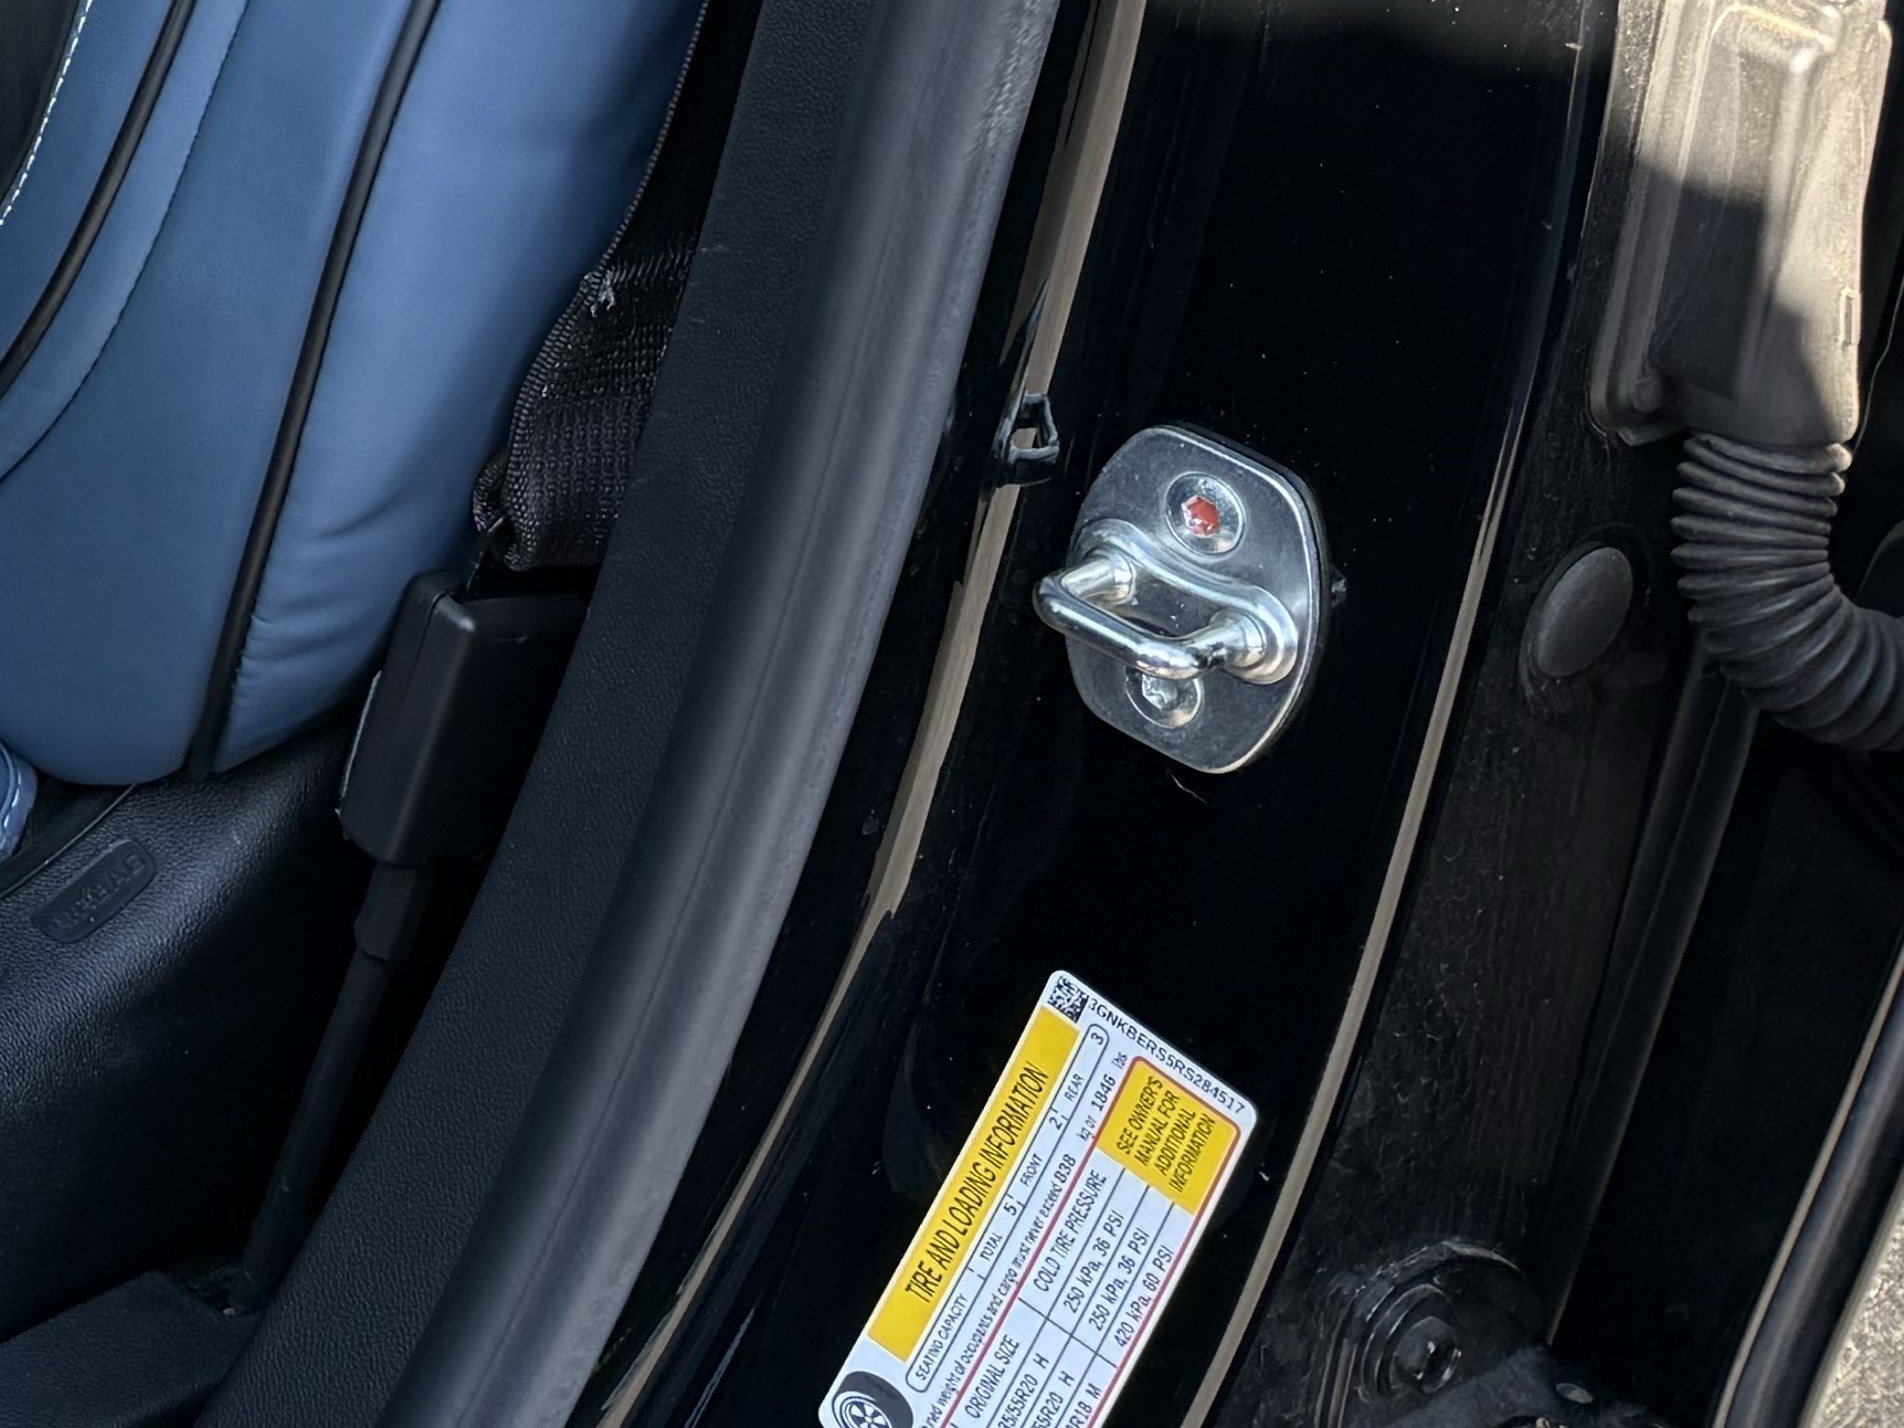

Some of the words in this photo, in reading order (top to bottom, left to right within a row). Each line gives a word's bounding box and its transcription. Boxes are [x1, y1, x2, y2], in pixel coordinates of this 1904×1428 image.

[978, 1061, 1049, 1170] INFORMATION
[1116, 1127, 1139, 1155] SEE
[1127, 1076, 1163, 1131] OWNER'S
[1134, 1117, 1169, 1166] MANUAL
[1157, 1090, 1180, 1119] FOR
[1154, 1108, 1197, 1176] ADDITIONAL
[1166, 1113, 1216, 1193] INFORMATION
[915, 1340, 944, 1381] SEATING
[938, 1293, 968, 1340] CAPACITY
[979, 1232, 1003, 1261] TOTAL
[1003, 1202, 1017, 1216] 5
[1020, 1153, 1043, 1187] FRONT
[1049, 1117, 1063, 1131] 2
[1064, 1073, 1084, 1101] REAR
[1091, 1032, 1104, 1045] 3
[936, 1372, 961, 1407] weight
[954, 1360, 966, 1375] of
[960, 1314, 993, 1364] occupants
[986, 1293, 1003, 1316] and
[997, 1268, 1018, 1297] cargo
[1012, 1242, 1031, 1268] must
[1024, 1216, 1044, 1245] never
[1039, 1181, 1063, 1218] exceed
[1053, 1154, 1076, 1184] 838
[1085, 1115, 1097, 1129] or
[1091, 1073, 1116, 1112] 1846
[1111, 1052, 1128, 1070] lbs
[941, 1161, 996, 1236] LOADING
[1033, 1256, 1061, 1292] COLD
[1050, 1229, 1076, 1258] TIRE
[1064, 1169, 1107, 1235] PRESSURE
[904, 1260, 943, 1303] TIRE
[925, 1229, 960, 1271] AND
[1063, 1286, 1085, 1314] 250
[1092, 1237, 1110, 1257] 36
[1103, 1210, 1124, 1237] PSI
[1088, 1304, 1110, 1332] 250
[1117, 1255, 1136, 1275] 36
[1127, 1227, 1150, 1255] PSI
[1114, 1321, 1135, 1347] 420
[1142, 1272, 1160, 1292] 60
[1152, 1244, 1174, 1272] PSI
[964, 1364, 1005, 1419] ORIGINAL
[994, 1334, 1020, 1365] SIZE
[1032, 1353, 1049, 1369] H
[1058, 1370, 1075, 1387] H
[1085, 1383, 1101, 1399] M
